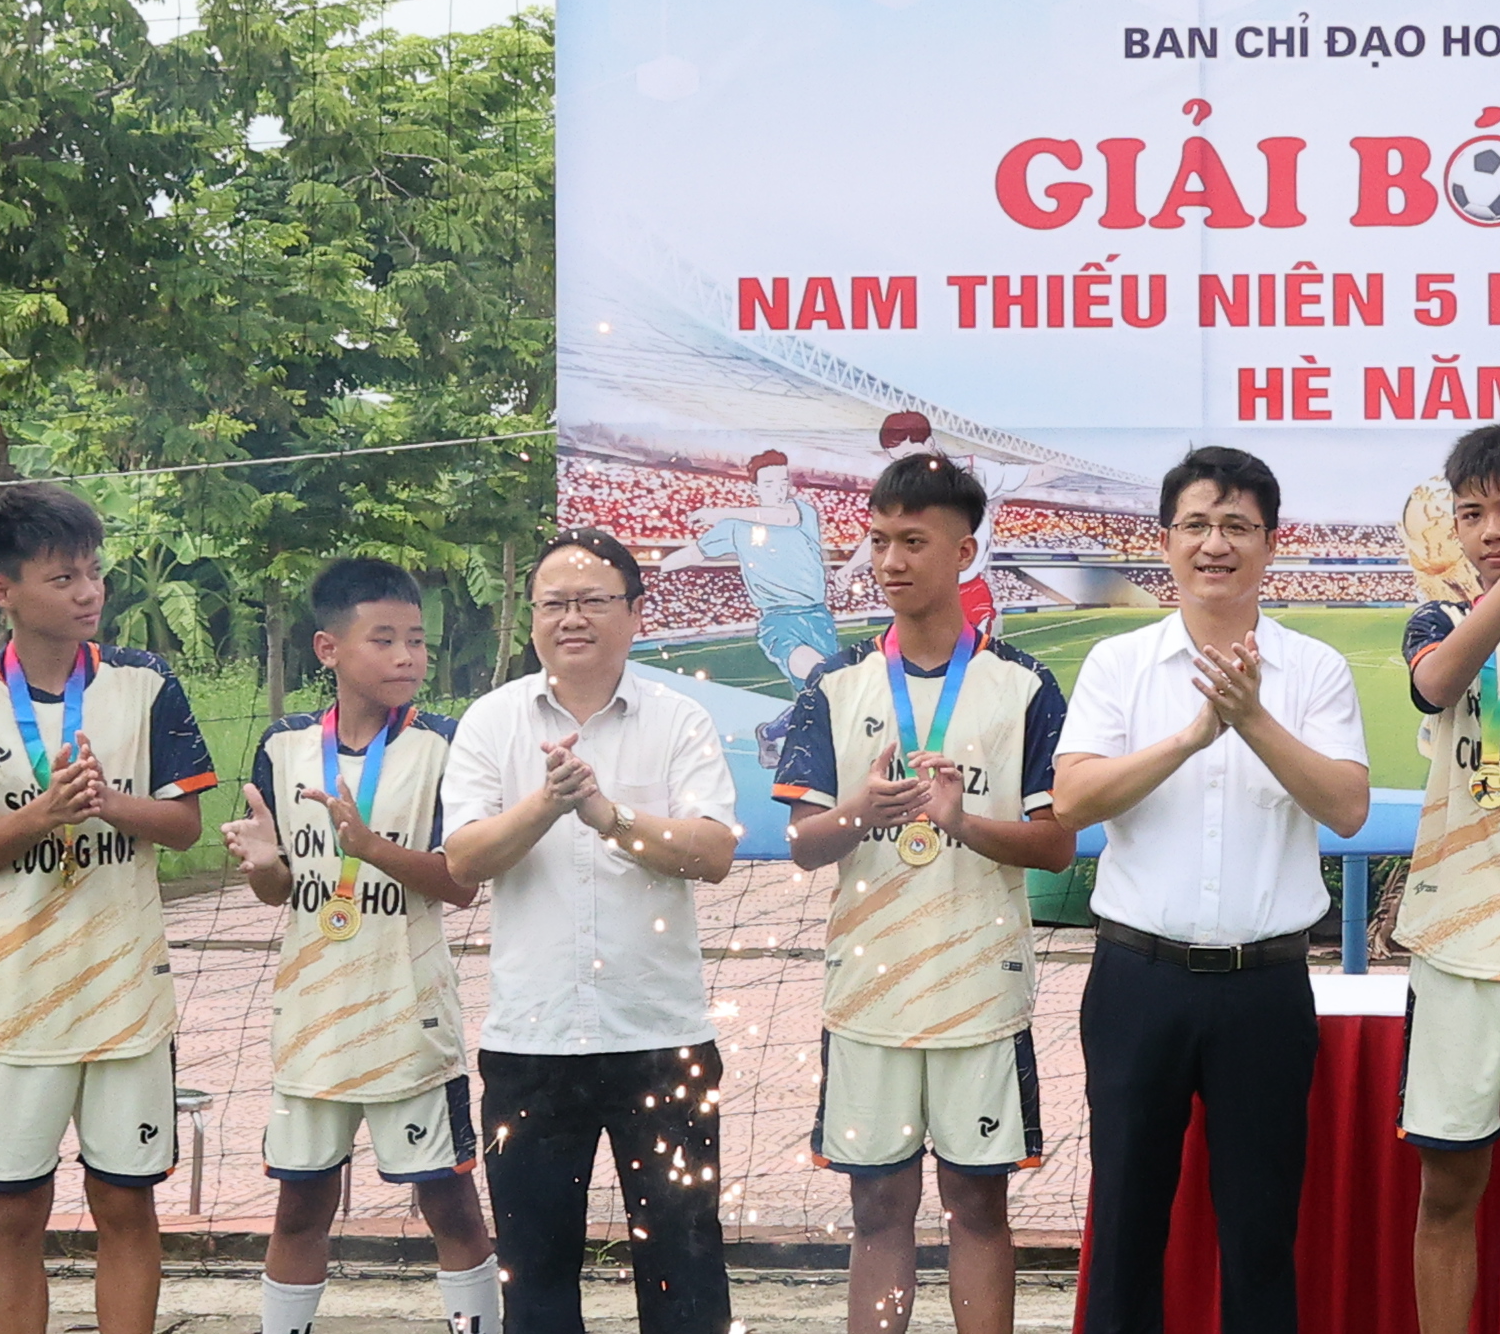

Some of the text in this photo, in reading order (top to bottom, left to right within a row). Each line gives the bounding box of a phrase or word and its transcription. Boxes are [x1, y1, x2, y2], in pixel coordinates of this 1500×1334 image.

[1123, 26, 1218, 59] BAN
[1234, 12, 1309, 59] CHỈ
[1325, 24, 1427, 68] ĐẠO
[994, 97, 1308, 231] GIẢI
[737, 275, 918, 331] NAM
[947, 253, 1168, 330] THIẾU
[1198, 260, 1385, 328] NIÊN
[1413, 273, 1458, 327] 5
[1237, 354, 1332, 421] HÈ
[290, 823, 325, 858] ƠN
